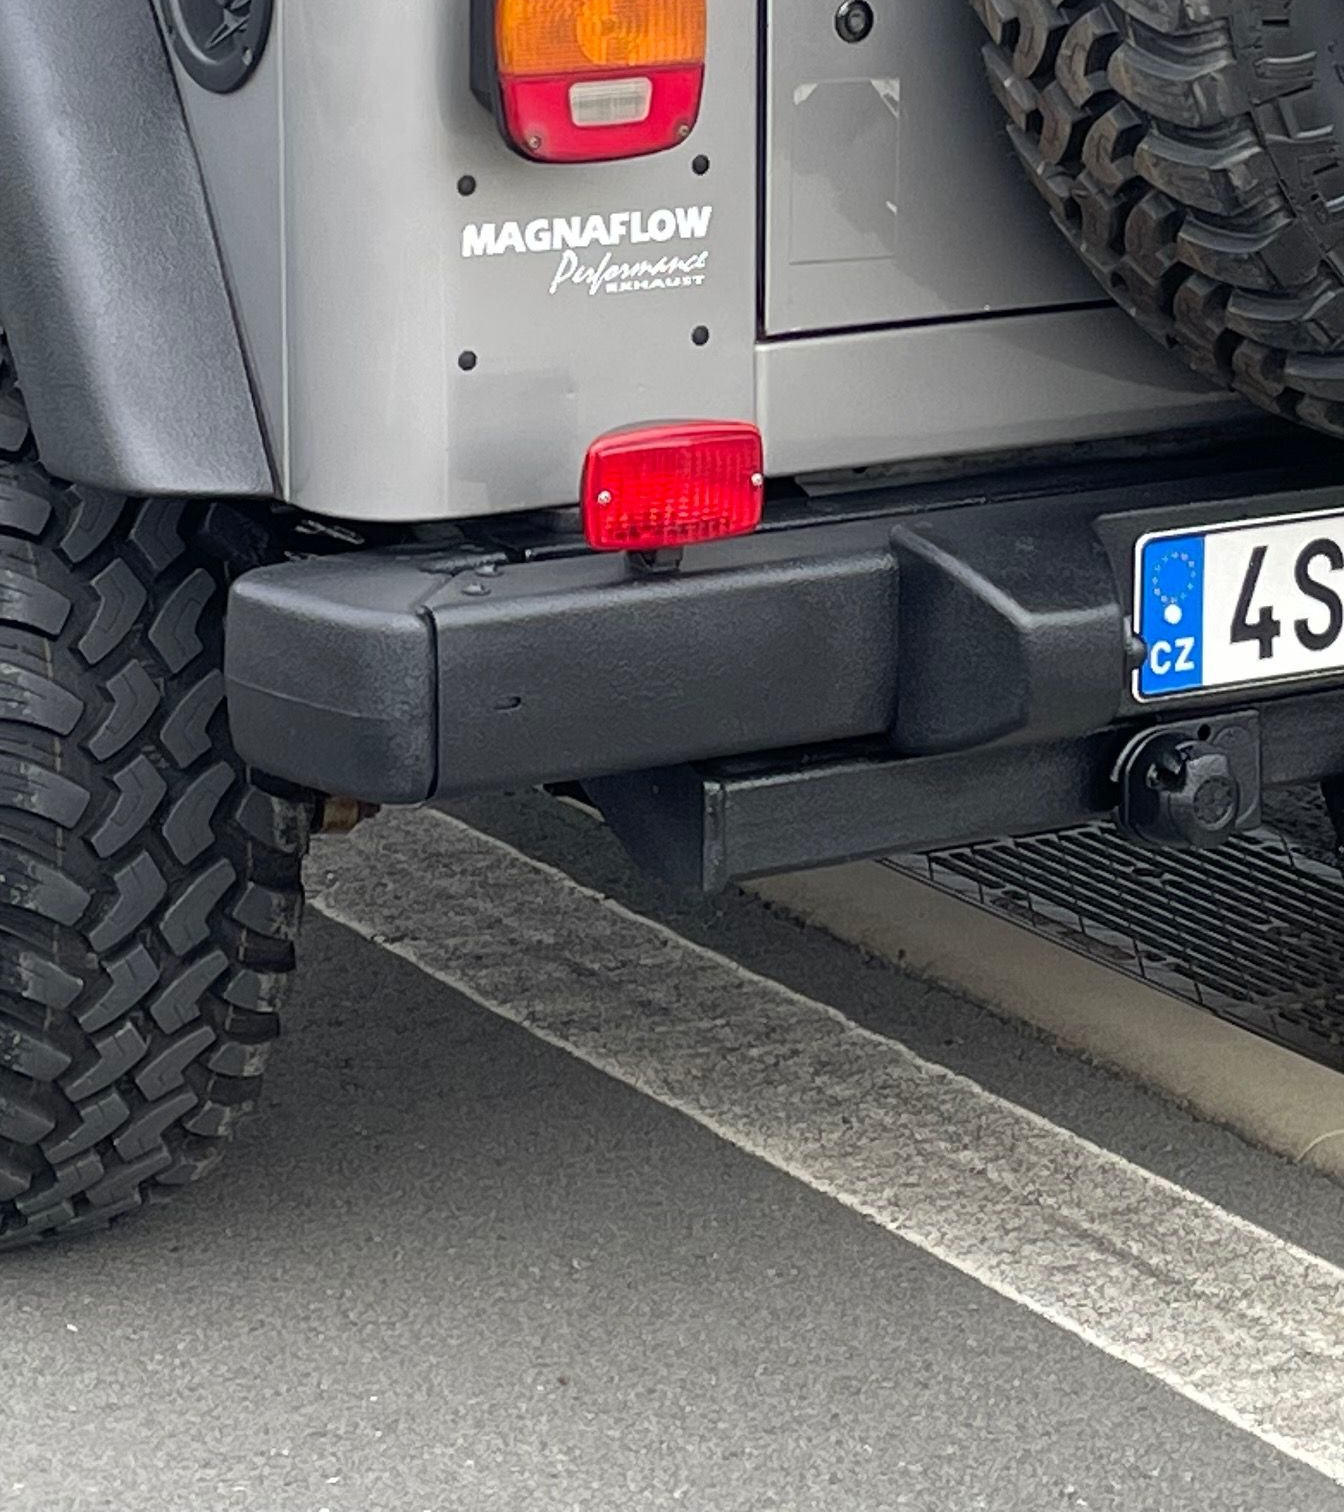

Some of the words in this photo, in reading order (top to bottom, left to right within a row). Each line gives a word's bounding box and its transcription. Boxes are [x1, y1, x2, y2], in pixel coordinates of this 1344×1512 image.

[461, 205, 713, 258] MAGNAFLOW
[549, 249, 709, 295] Performance
[605, 274, 705, 294] EXHAUST
[1149, 636, 1196, 676] CZ
